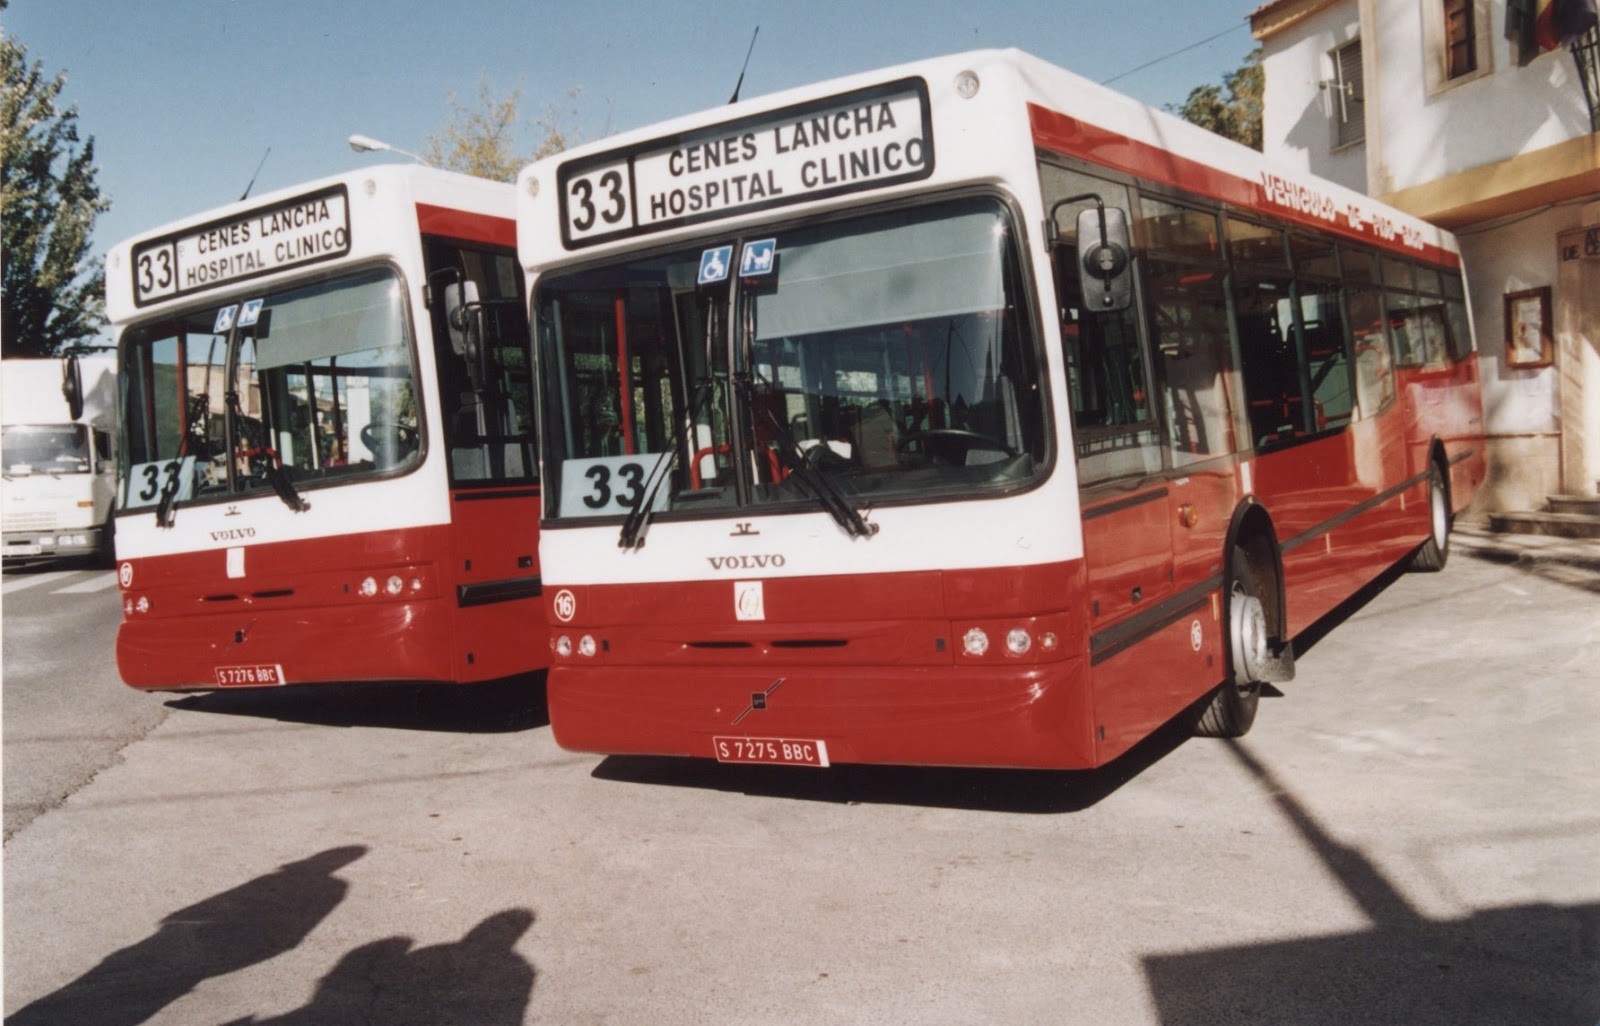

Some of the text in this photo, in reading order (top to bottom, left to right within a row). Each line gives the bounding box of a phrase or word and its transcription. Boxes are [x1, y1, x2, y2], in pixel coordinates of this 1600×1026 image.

[668, 102, 897, 177] CENES LANCHA
[650, 137, 925, 219] HOSPITAL CLINICO
[571, 170, 627, 231] 33
[199, 200, 329, 254] CENES LANCHA
[138, 250, 172, 293] 33
[187, 227, 347, 286] HOSPITAL CLINICO
[140, 461, 180, 501] 33
[583, 463, 645, 509] 33
[210, 527, 255, 541] VOLVO
[708, 554, 786, 570] VOLVO
[557, 595, 572, 615] 16
[219, 668, 276, 683] S 7276 BBC
[719, 742, 813, 761] S 7275 BBC
